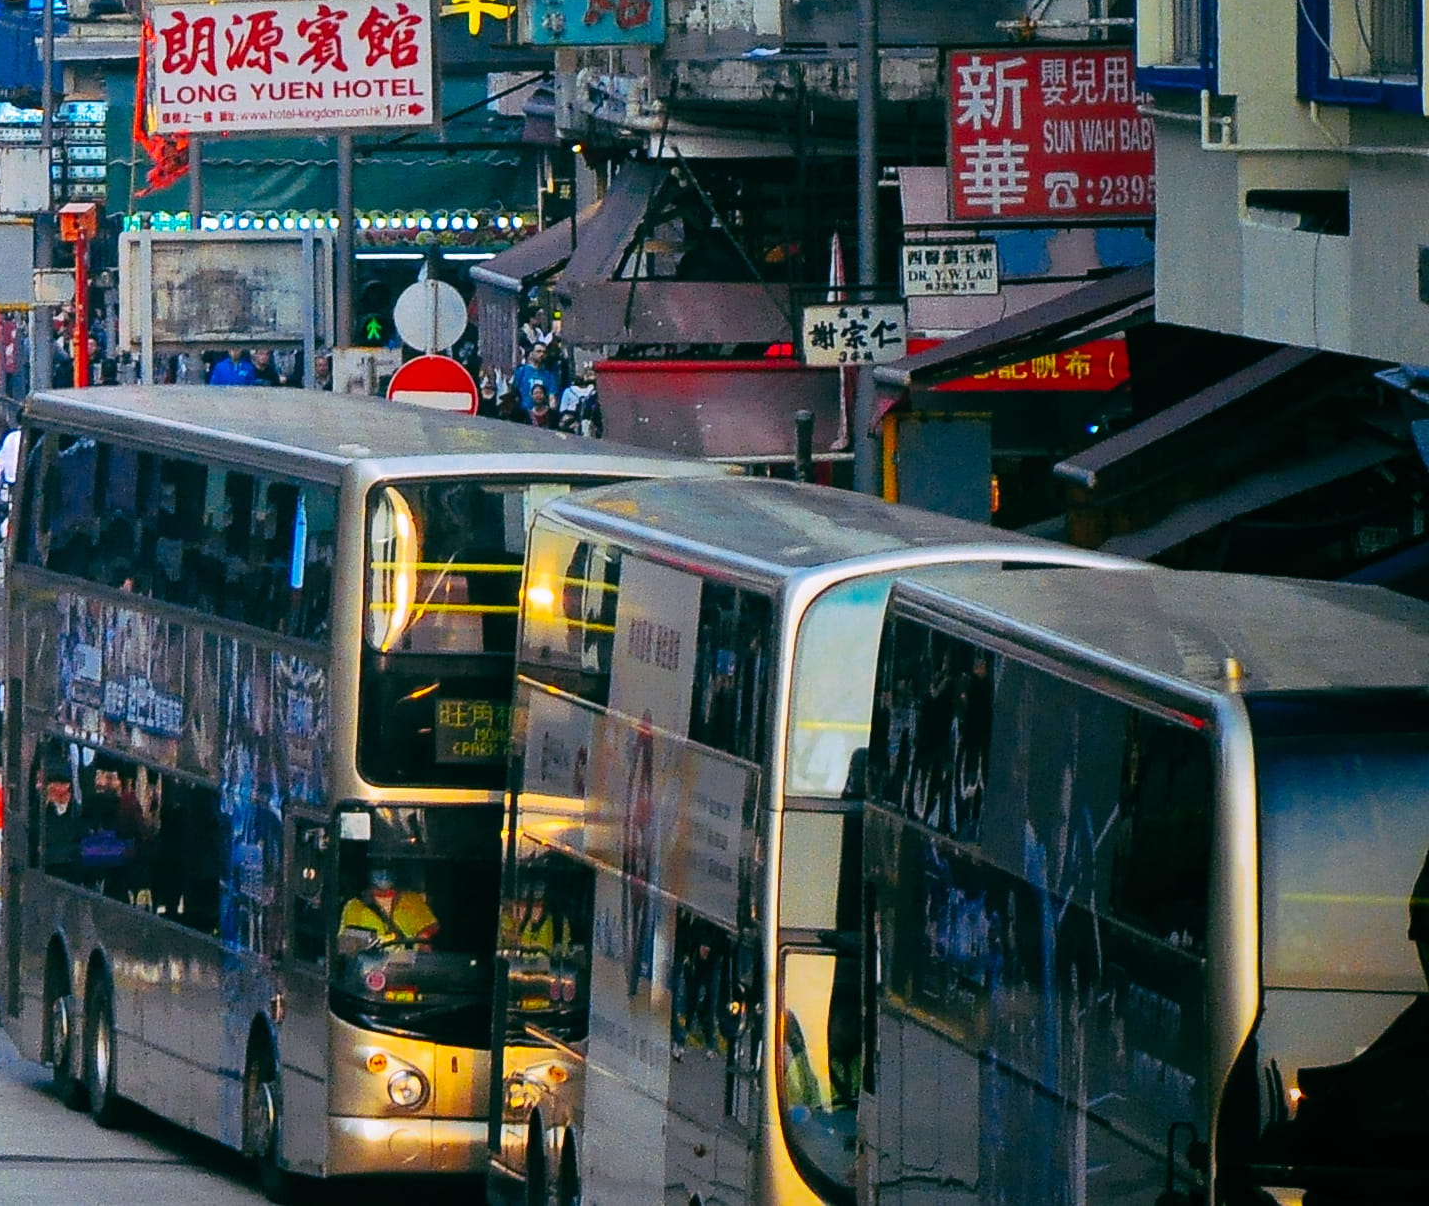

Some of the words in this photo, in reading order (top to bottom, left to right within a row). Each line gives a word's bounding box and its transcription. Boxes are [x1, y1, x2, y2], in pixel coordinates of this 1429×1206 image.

[159, 2, 427, 77] 朗源賓館
[160, 84, 237, 104] LONG
[250, 81, 324, 101] YUEN
[333, 78, 424, 98] HOTEL
[1044, 120, 1075, 153] SUN
[1080, 118, 1115, 152] WAH
